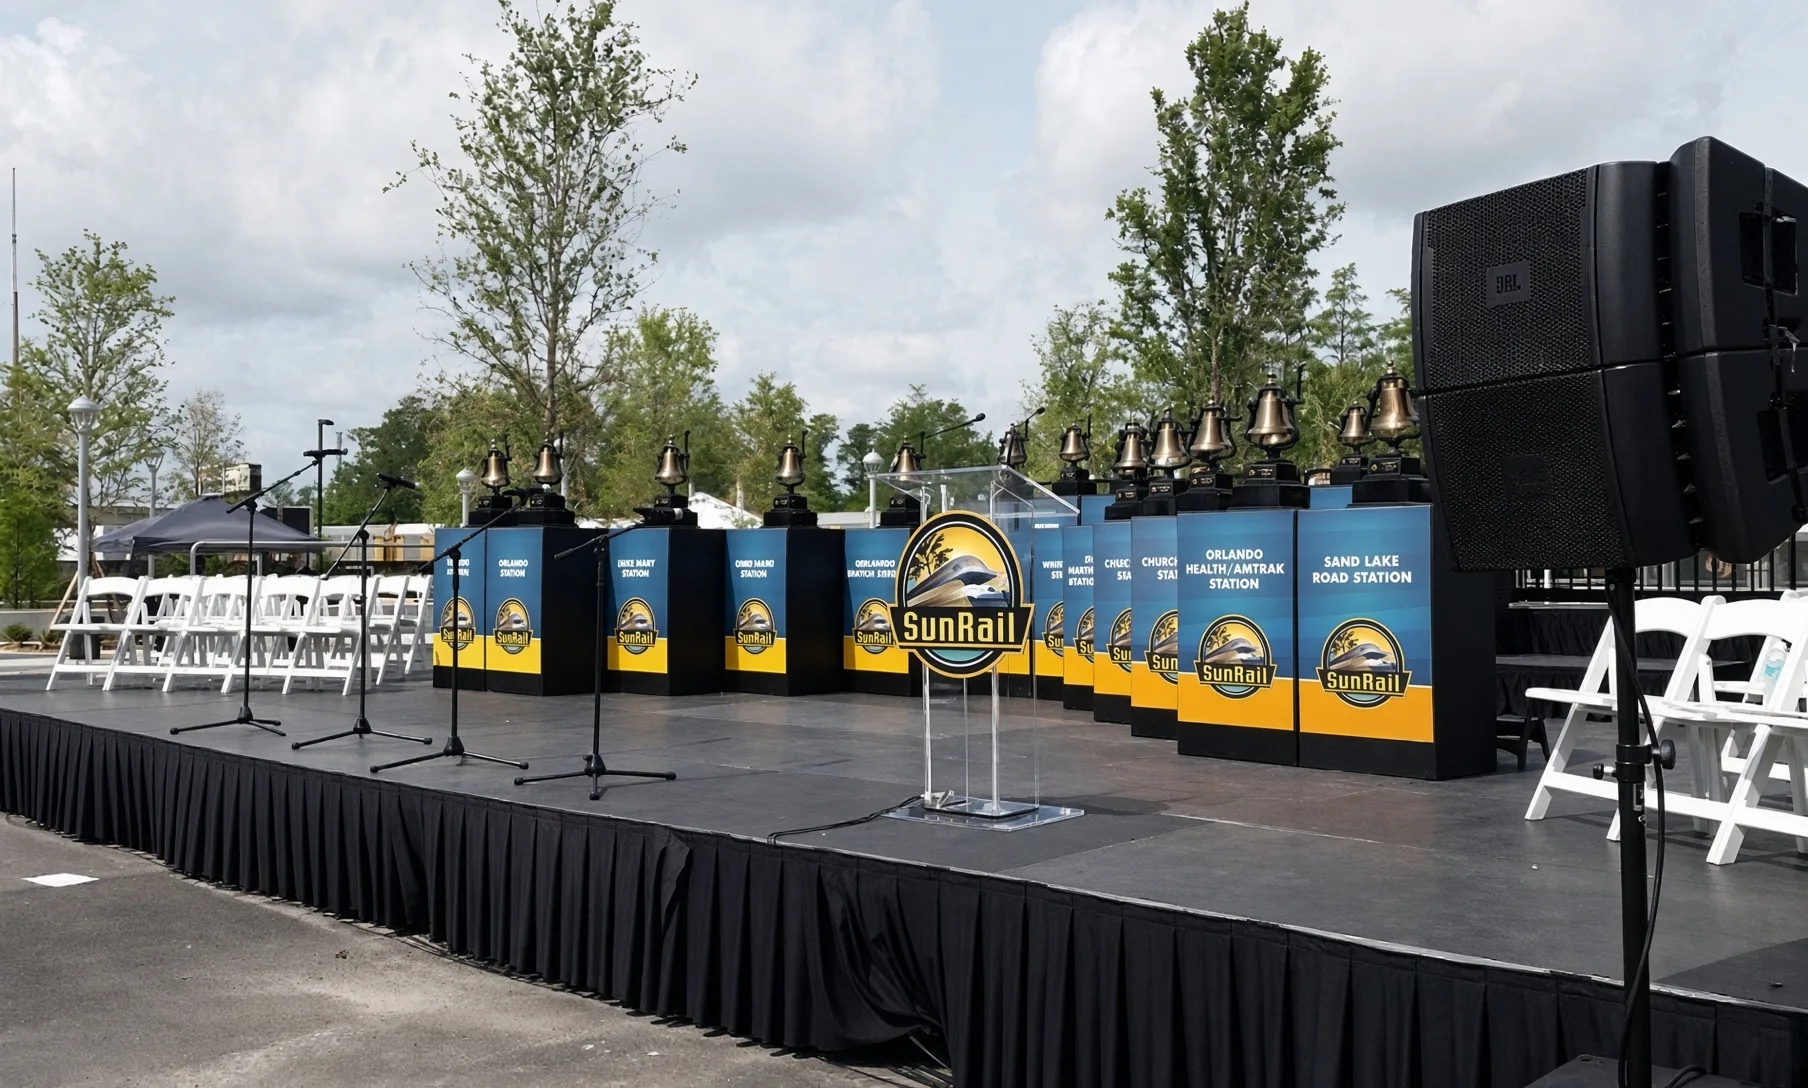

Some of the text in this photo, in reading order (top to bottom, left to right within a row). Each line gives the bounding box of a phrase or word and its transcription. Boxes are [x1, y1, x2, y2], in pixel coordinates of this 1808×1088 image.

[1206, 549, 1264, 560] ORLANDO
[1324, 554, 1400, 568] SAND LAKE
[500, 569, 526, 578] STATION
[622, 569, 650, 578] STATION
[740, 569, 768, 578] STATION
[1186, 563, 1285, 576] HEALTH/AMTRAK
[1209, 578, 1259, 589] STATION
[1312, 571, 1412, 584] ROAD STATION
[903, 611, 1015, 643] SunRail
[443, 628, 473, 641] SuRail
[619, 631, 653, 644] SunRail
[737, 631, 772, 645] SunRail
[857, 631, 892, 644] SunRail
[1203, 664, 1267, 684] SunRail
[1327, 671, 1400, 692] SunRail
